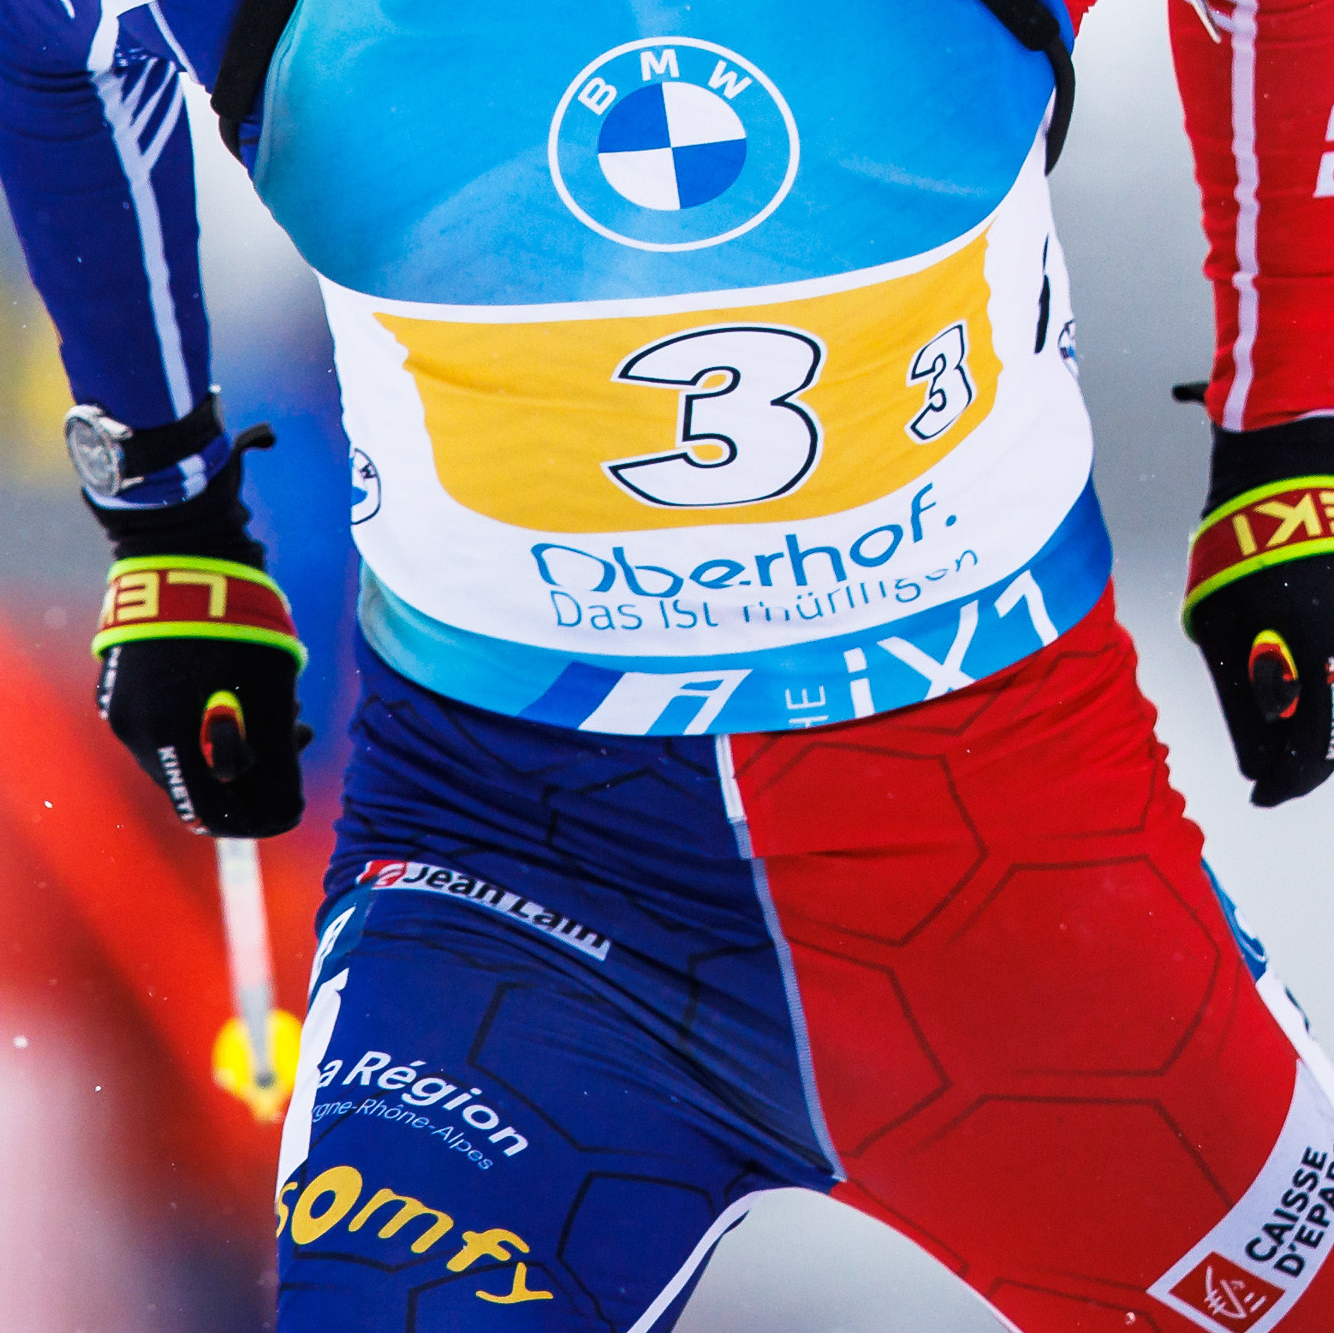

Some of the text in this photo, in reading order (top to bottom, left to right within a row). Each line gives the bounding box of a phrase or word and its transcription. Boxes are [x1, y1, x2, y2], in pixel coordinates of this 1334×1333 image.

[578, 48, 754, 117] BMW
[603, 326, 826, 509] 3
[905, 322, 976, 443] 3
[550, 589, 643, 631] Das
[402, 865, 507, 906] Jean
[341, 1050, 530, 1158] Région
[1245, 1145, 1328, 1263] CAISSE
